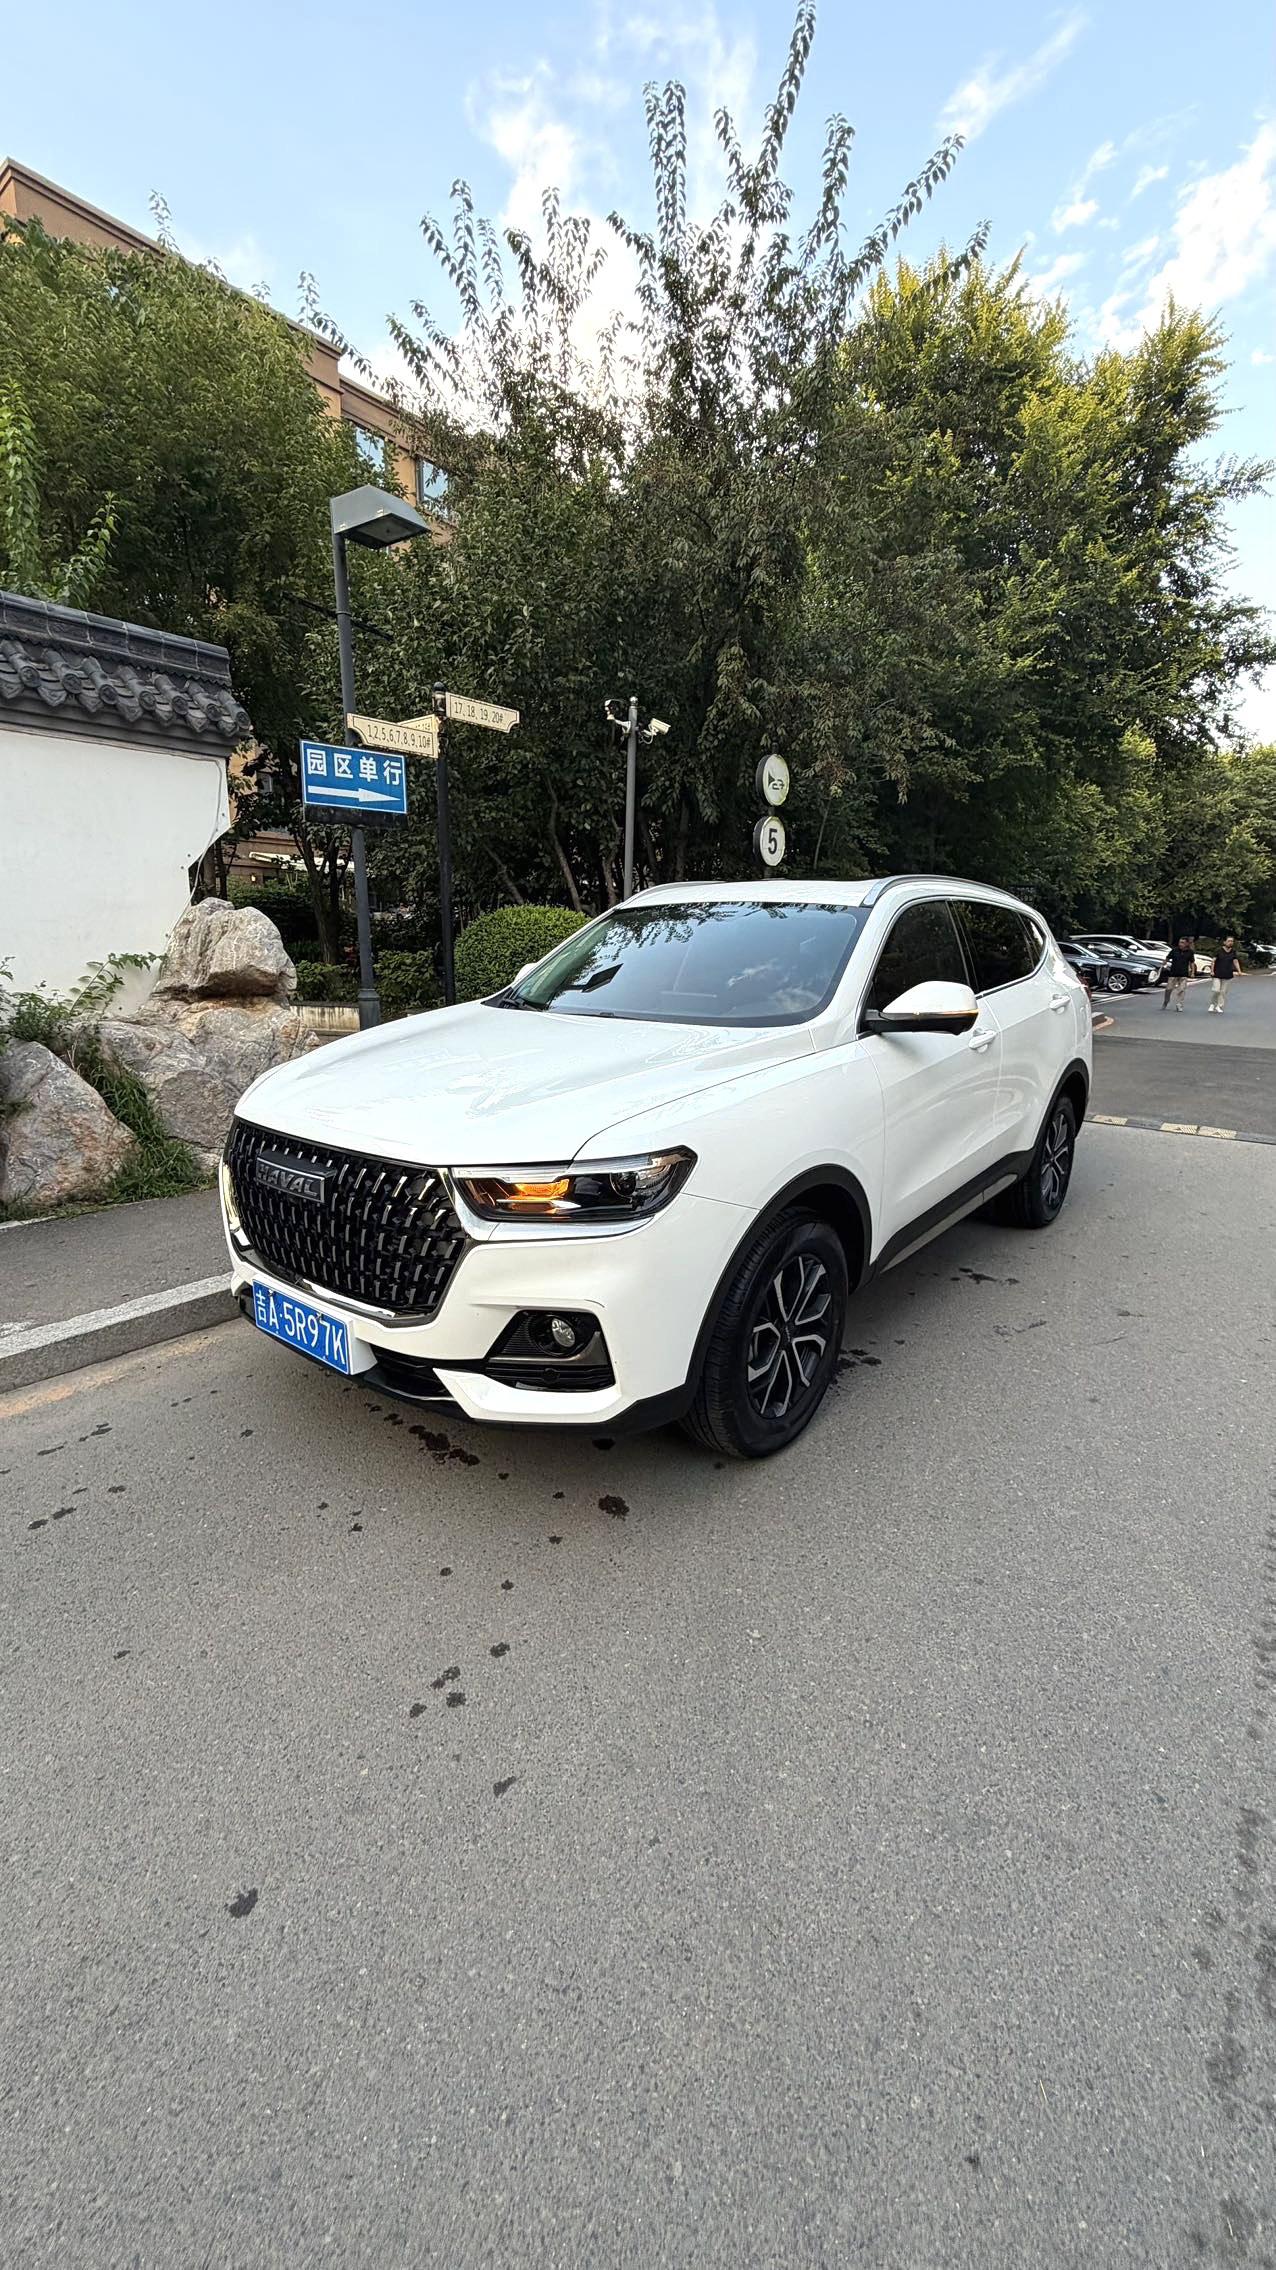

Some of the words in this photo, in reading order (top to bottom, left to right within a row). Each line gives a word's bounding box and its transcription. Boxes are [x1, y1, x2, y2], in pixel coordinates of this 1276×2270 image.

[306, 748, 402, 786] 园区单行
[767, 828, 778, 855] 5
[257, 1163, 318, 1197] HAVAL
